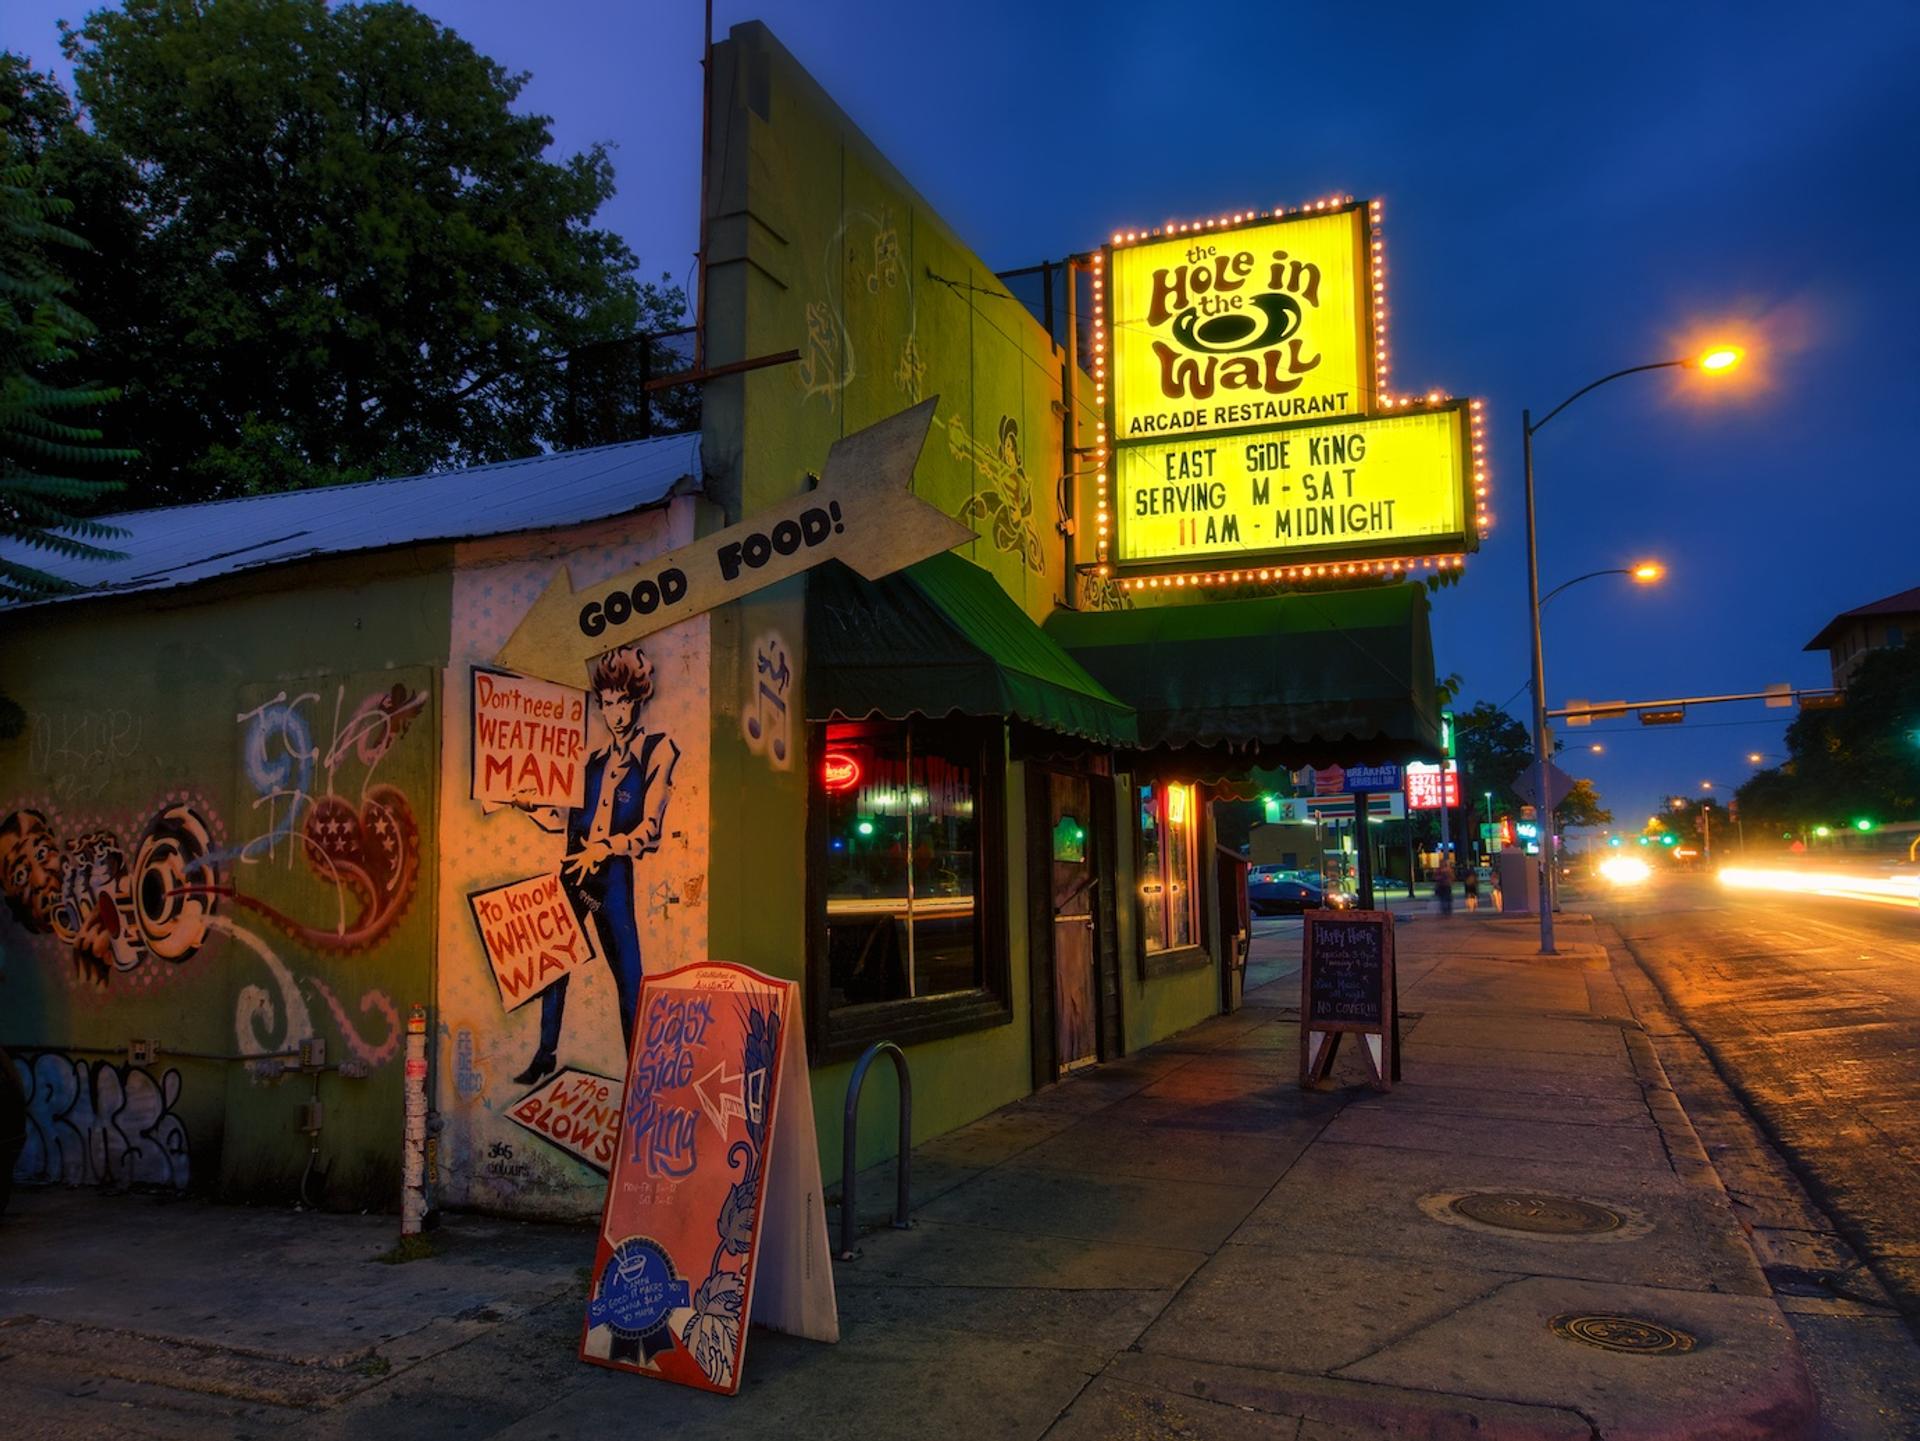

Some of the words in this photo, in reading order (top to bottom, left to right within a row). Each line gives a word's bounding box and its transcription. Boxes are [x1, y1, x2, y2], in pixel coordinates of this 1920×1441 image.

[1186, 245, 1217, 265] the
[1267, 250, 1321, 307] in
[1198, 294, 1243, 317] the
[1130, 409, 1207, 434] ARCADE
[1214, 392, 1349, 423] RESTAURANT
[1166, 449, 1217, 481] EAST
[1135, 481, 1226, 516] SERVING
[1276, 500, 1396, 539] MIDNIGHT
[578, 568, 688, 638] GOOD
[717, 500, 845, 581] FOOD!
[477, 675, 522, 711] Don't
[523, 695, 565, 720] need
[571, 699, 582, 722] a
[485, 752, 575, 797] MAN
[479, 900, 502, 925] to
[505, 874, 559, 915] know
[485, 902, 573, 965] WHICH
[500, 931, 578, 998] WAY
[645, 992, 715, 1048] East
[573, 1077, 609, 1101] the
[637, 1045, 694, 1095] Side
[513, 1098, 618, 1163] BLOWS
[549, 1082, 623, 1133] WIND
[488, 1142, 512, 1159] 365
